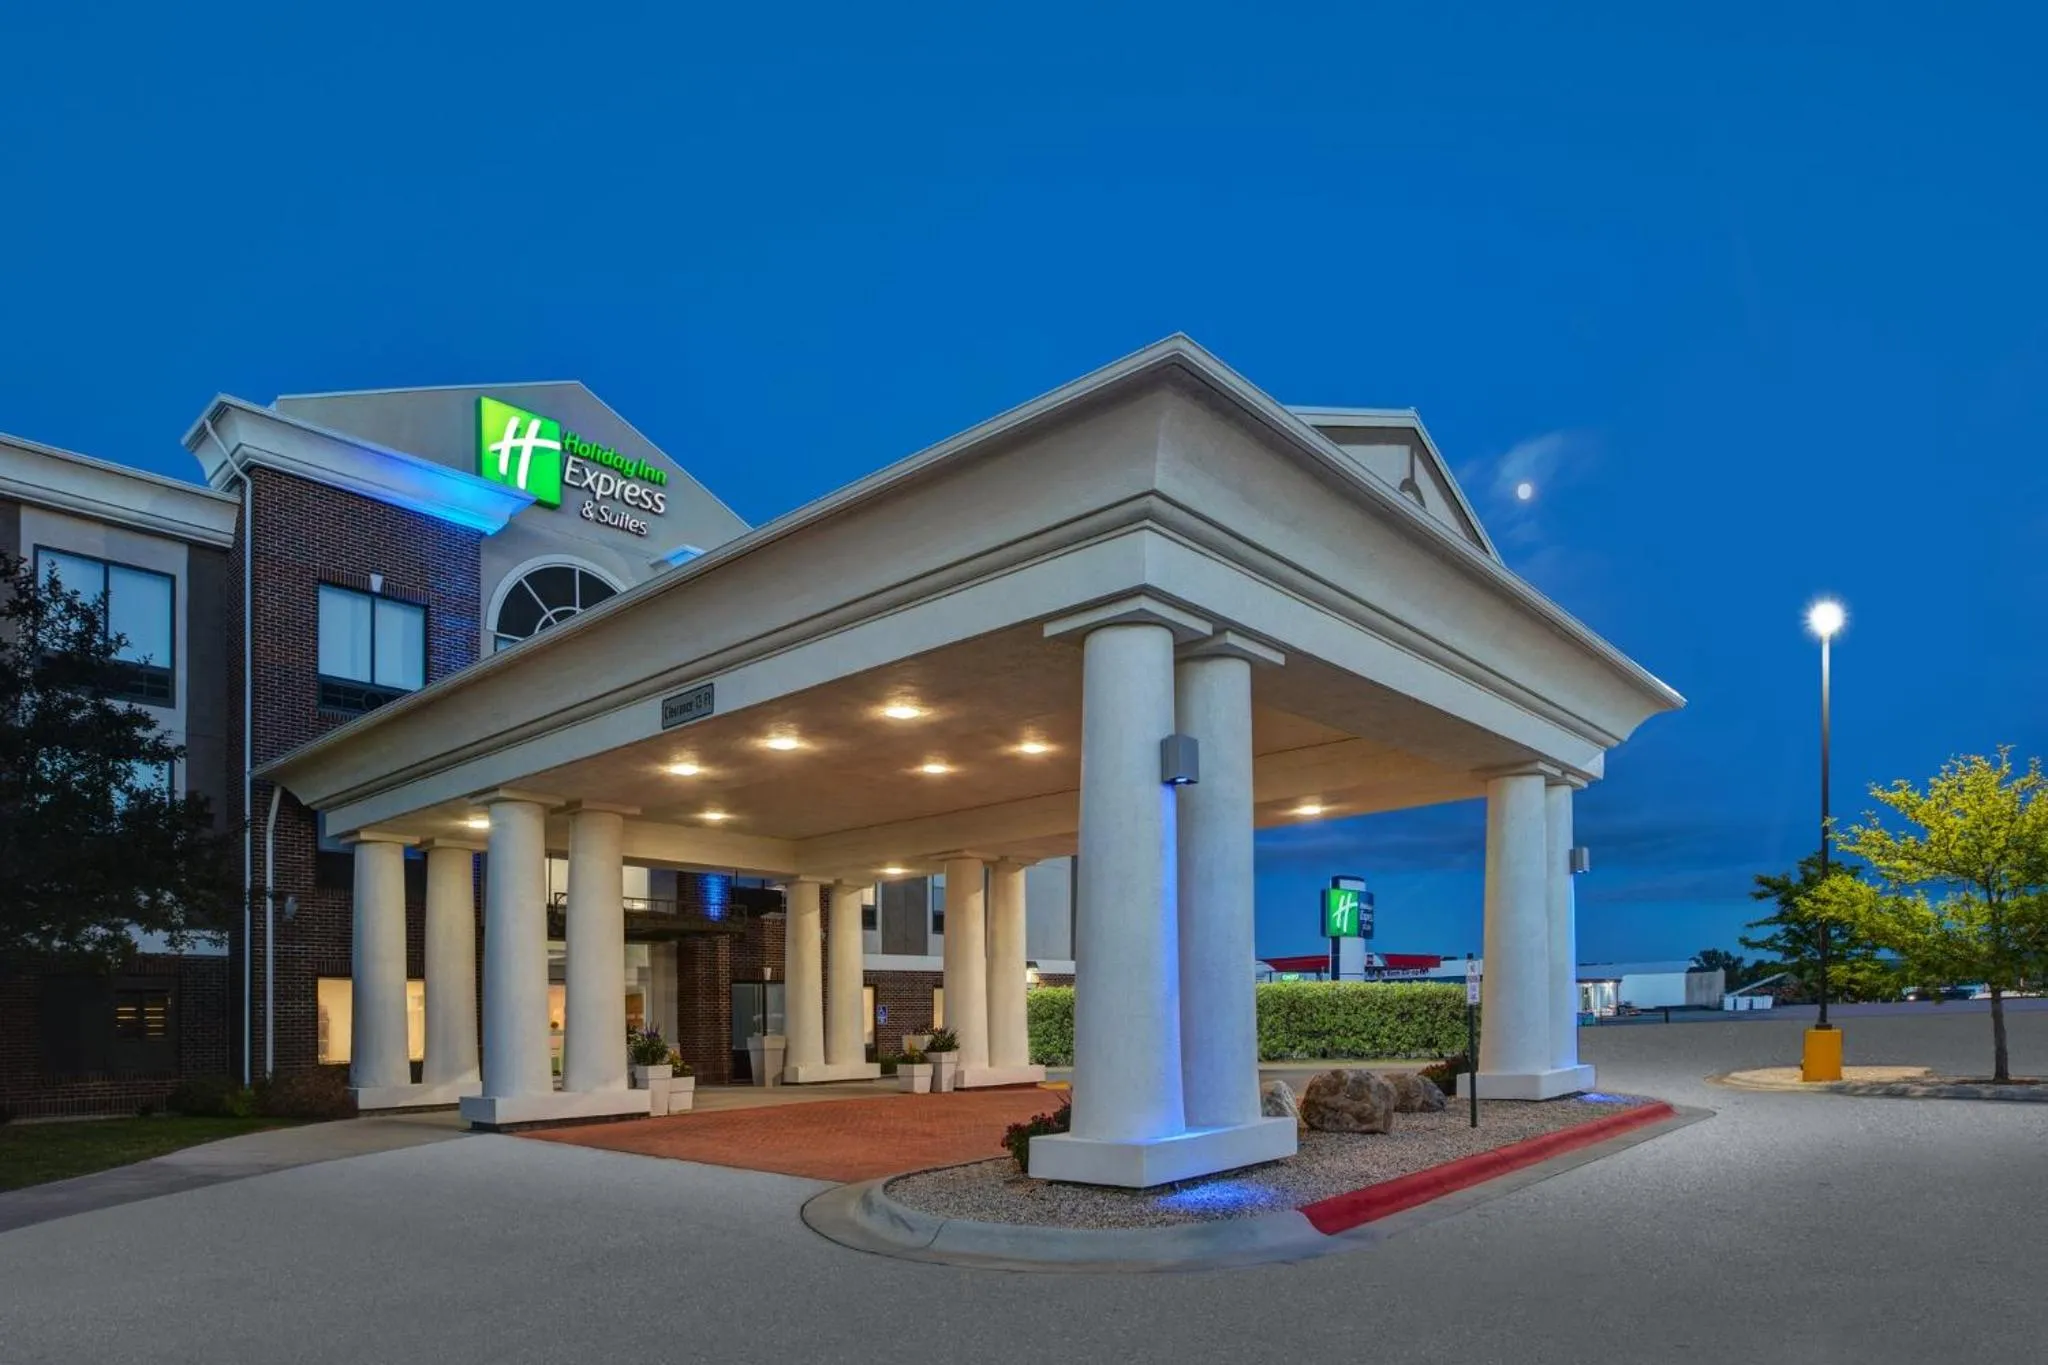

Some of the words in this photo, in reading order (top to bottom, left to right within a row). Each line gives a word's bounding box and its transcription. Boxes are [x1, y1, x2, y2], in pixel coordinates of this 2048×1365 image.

[563, 431, 638, 478] Holiday
[638, 459, 668, 486] Inn
[563, 455, 667, 515] Express
[580, 500, 595, 521] &
[598, 505, 648, 537] Suites
